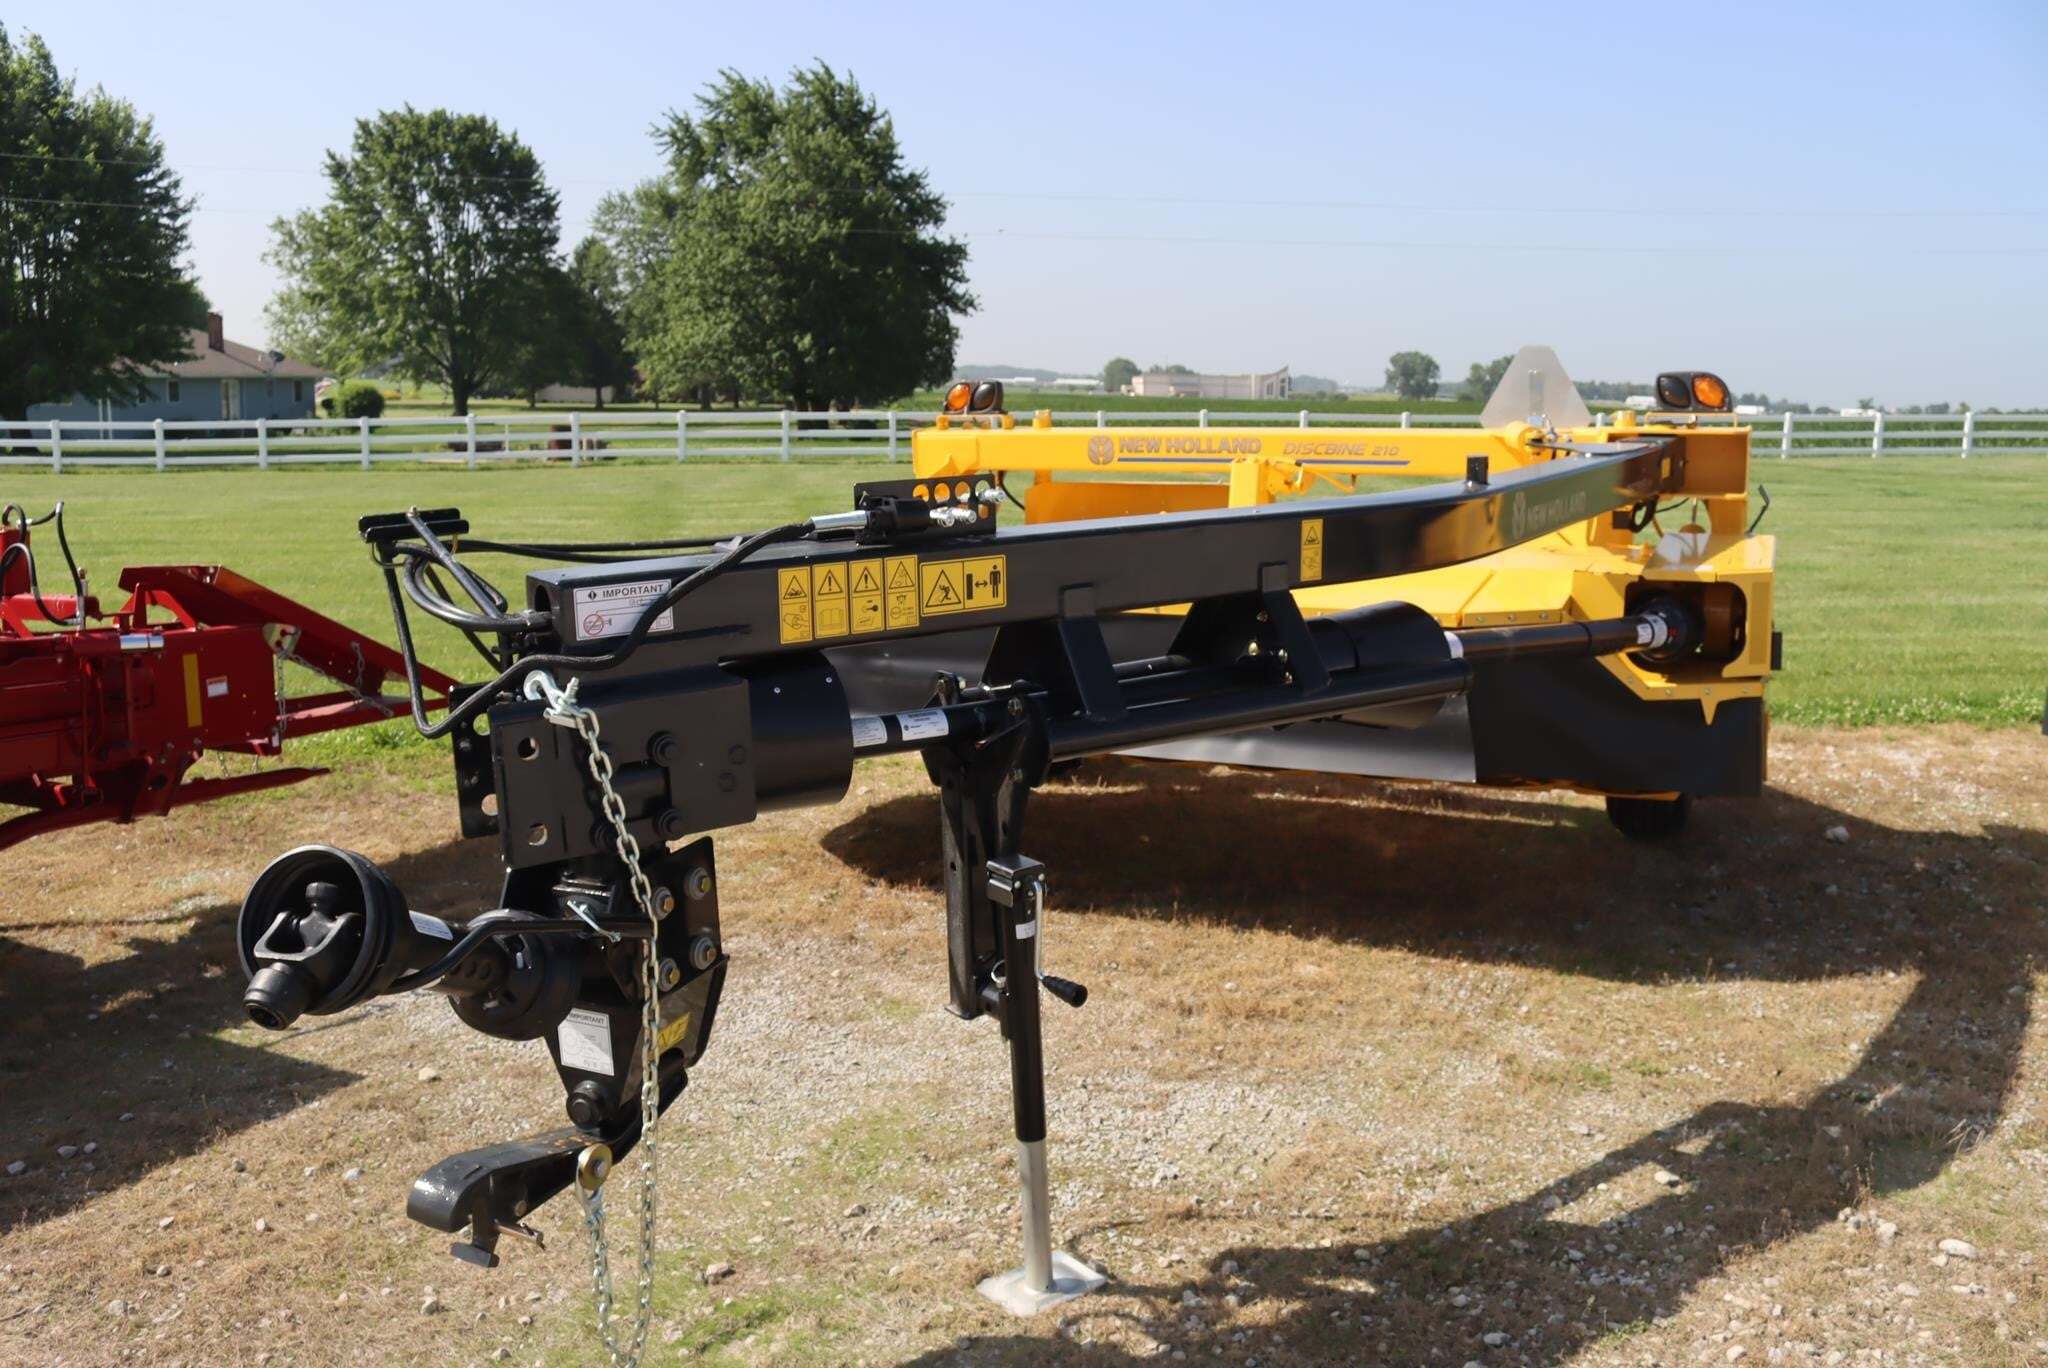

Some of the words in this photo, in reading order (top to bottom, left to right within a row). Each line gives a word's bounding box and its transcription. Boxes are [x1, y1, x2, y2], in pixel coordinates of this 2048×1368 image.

[1119, 437, 1161, 454] NEW
[1166, 437, 1262, 455] HOLLAND
[1283, 441, 1366, 456] DISCBINE
[1371, 445, 1399, 457] 210
[602, 584, 664, 599] IMPORTANT
[569, 1013, 605, 1025] IMPORTANT
